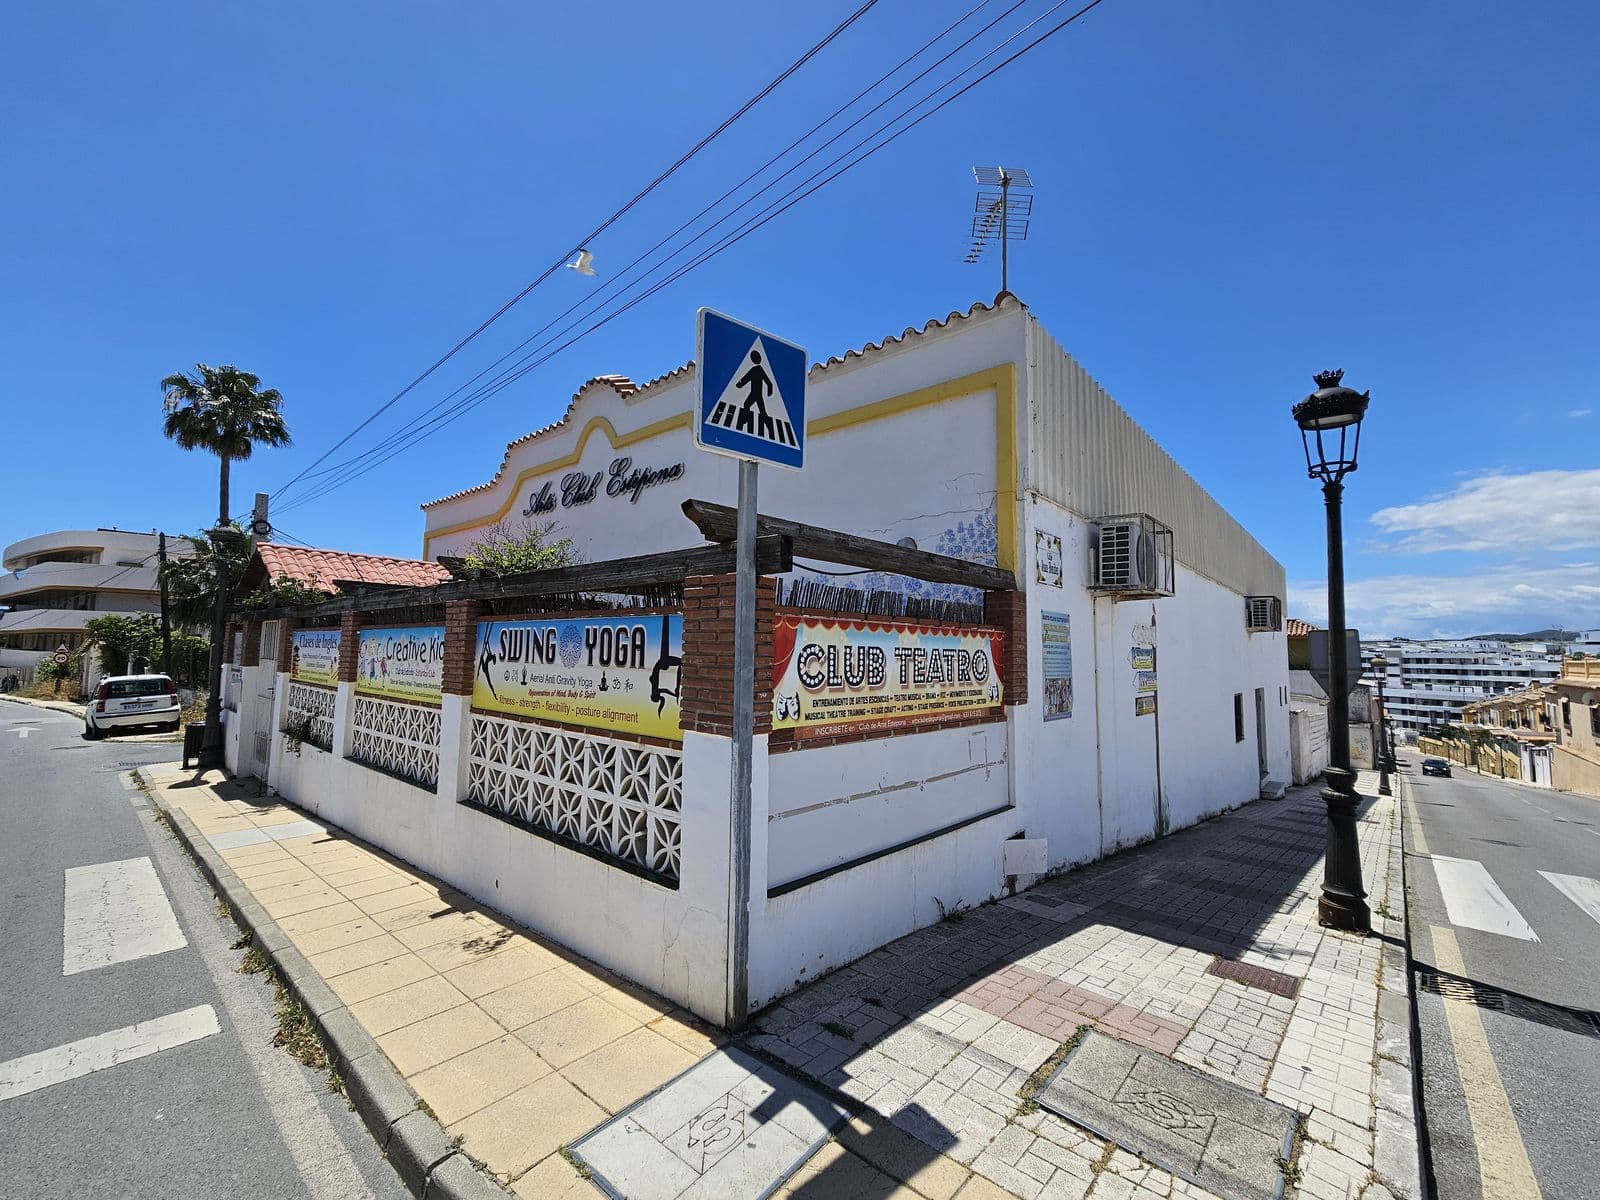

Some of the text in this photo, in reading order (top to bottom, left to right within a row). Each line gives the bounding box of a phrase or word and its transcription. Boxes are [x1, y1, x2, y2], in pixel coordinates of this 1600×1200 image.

[561, 471, 602, 507] Club
[607, 457, 684, 503] Estepona
[386, 635, 427, 663] Creative
[499, 624, 647, 669] SWING YOGA
[529, 672, 593, 690] Aerial Anti Gravity Yoga
[797, 643, 989, 689] CLUB TEATRO
[519, 698, 541, 711] strength
[545, 701, 571, 716] flexibility
[575, 705, 601, 717] posture
[602, 708, 638, 723] alignment
